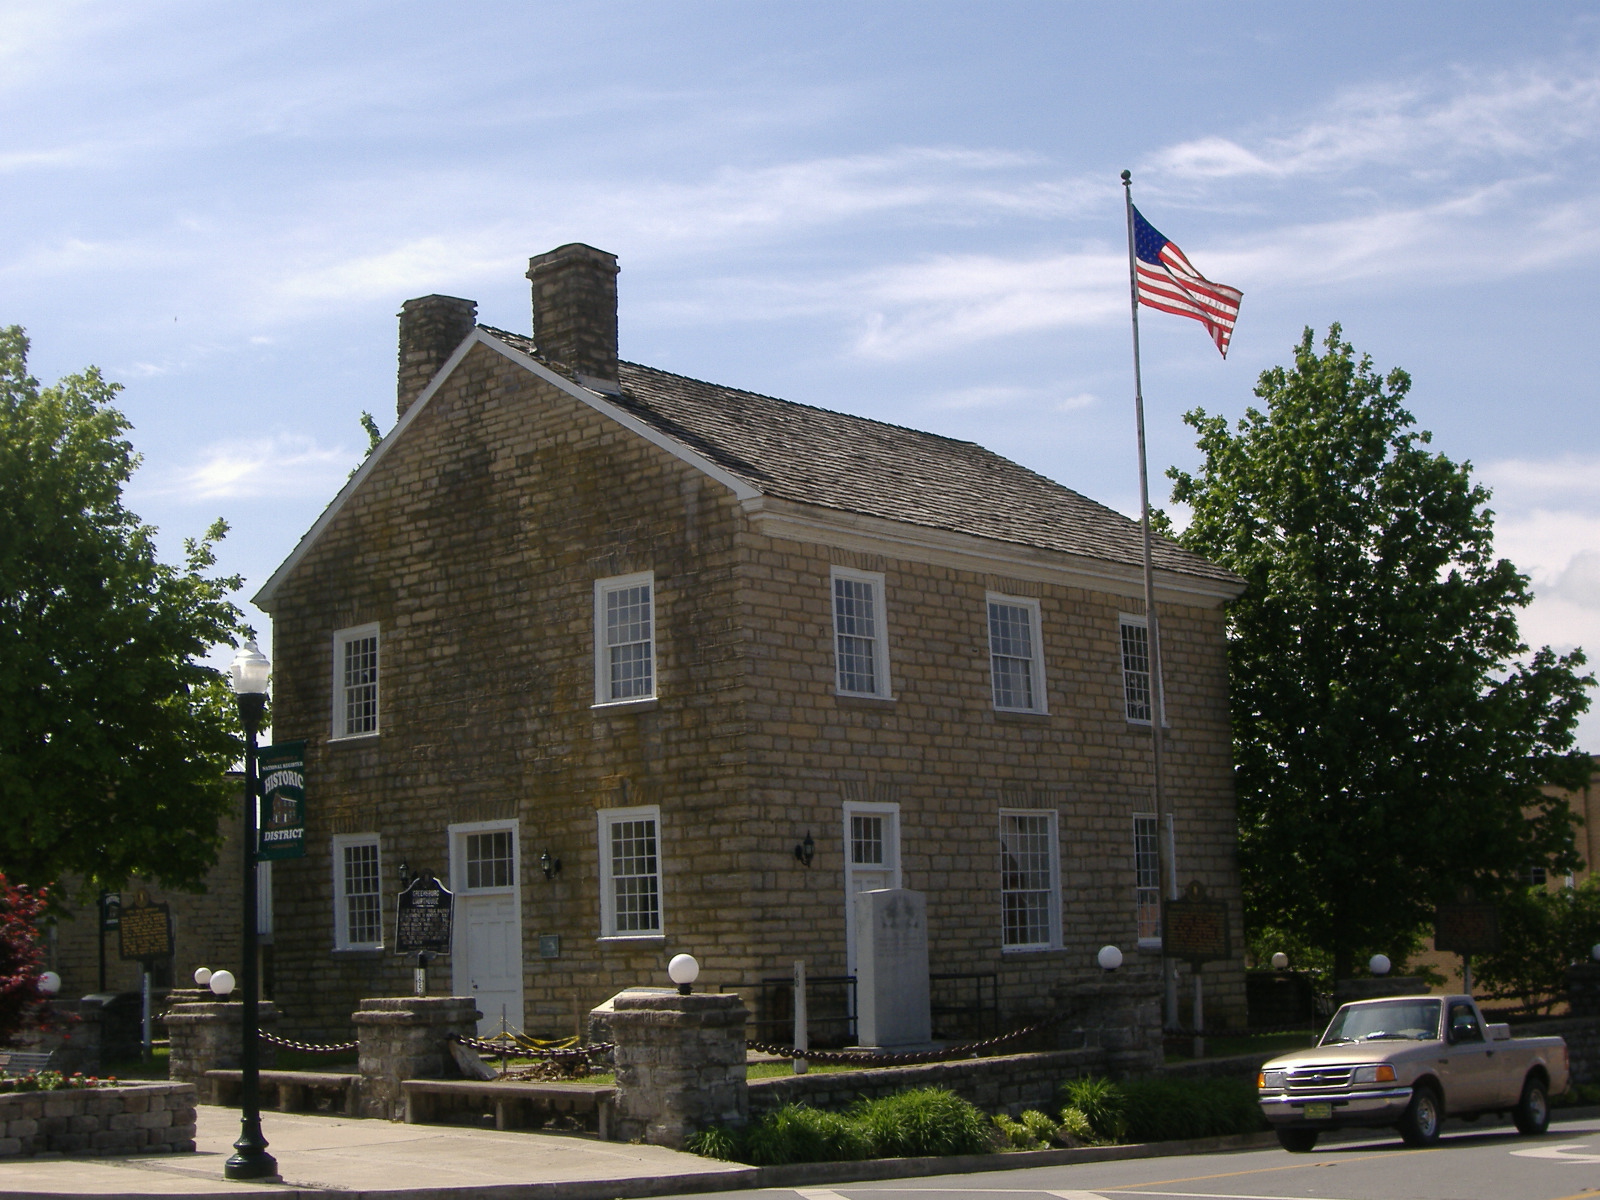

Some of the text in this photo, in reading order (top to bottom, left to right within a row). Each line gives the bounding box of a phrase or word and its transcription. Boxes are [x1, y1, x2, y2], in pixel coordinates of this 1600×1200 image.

[262, 761, 303, 771] NATIONAL REGISTER
[264, 770, 304, 795] HISTORIC
[264, 828, 304, 841] DISTRICT
